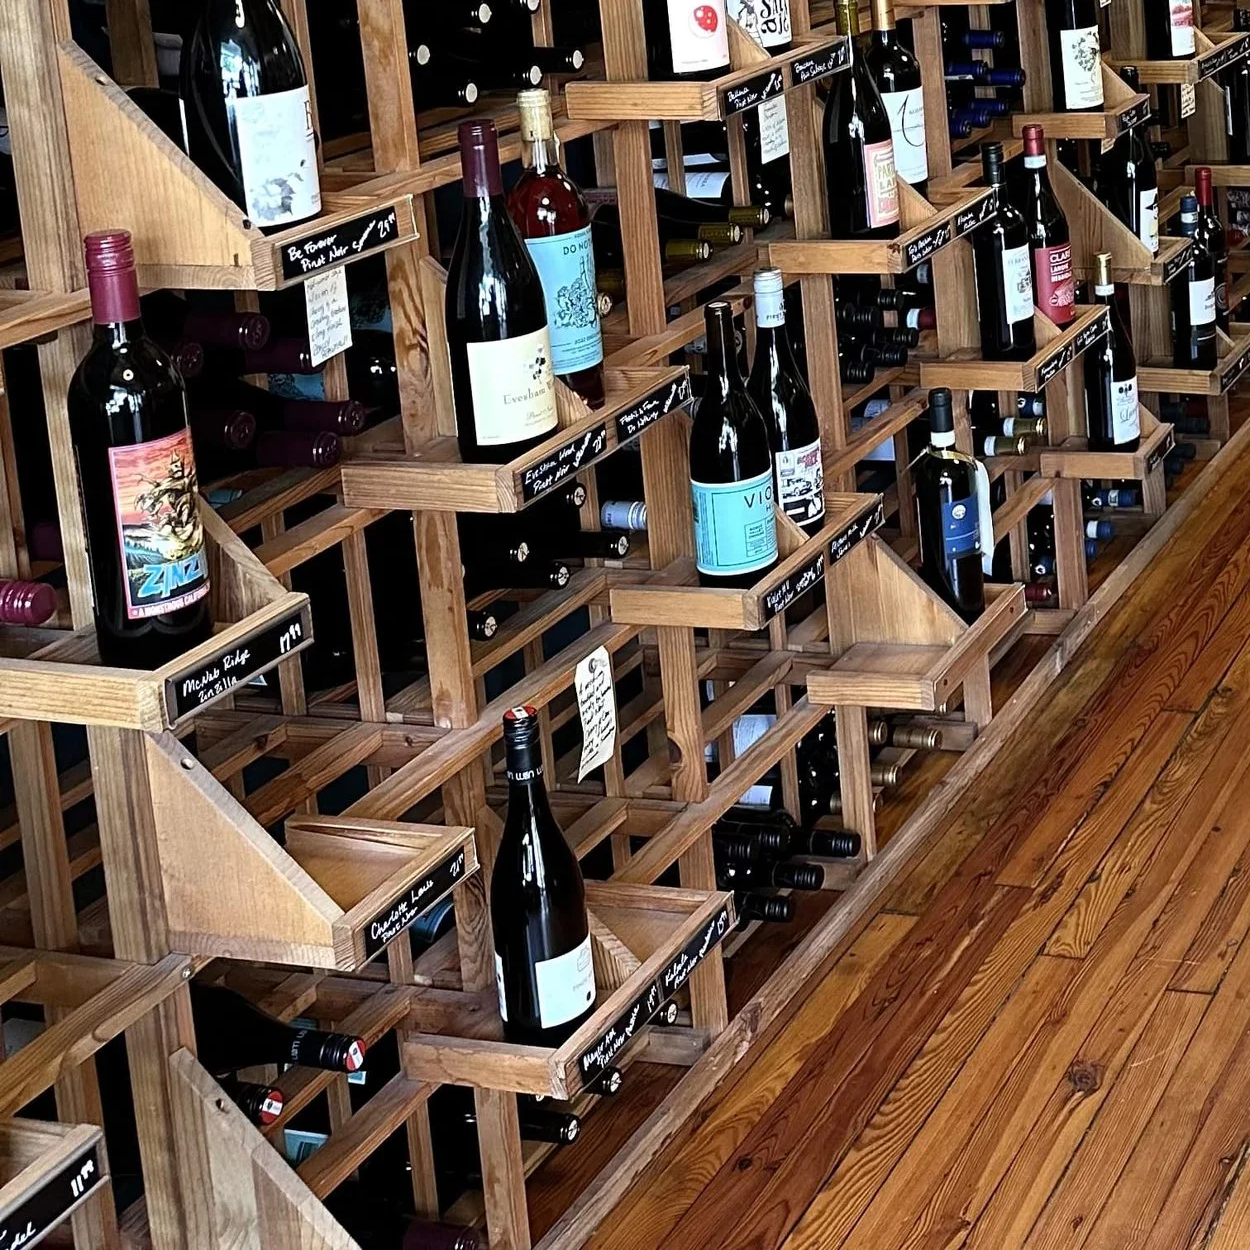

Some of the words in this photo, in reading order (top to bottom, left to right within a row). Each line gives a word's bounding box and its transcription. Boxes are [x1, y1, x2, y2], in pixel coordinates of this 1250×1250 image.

[287, 246, 303, 261] Be
[303, 234, 338, 255] Forever
[301, 254, 326, 273] Pinot
[329, 246, 349, 262] Noir
[563, 244, 577, 256] DO
[503, 386, 547, 406] Evesham
[183, 668, 220, 697] McNab
[223, 649, 251, 670] Ridge
[198, 675, 238, 704] Zinzilla
